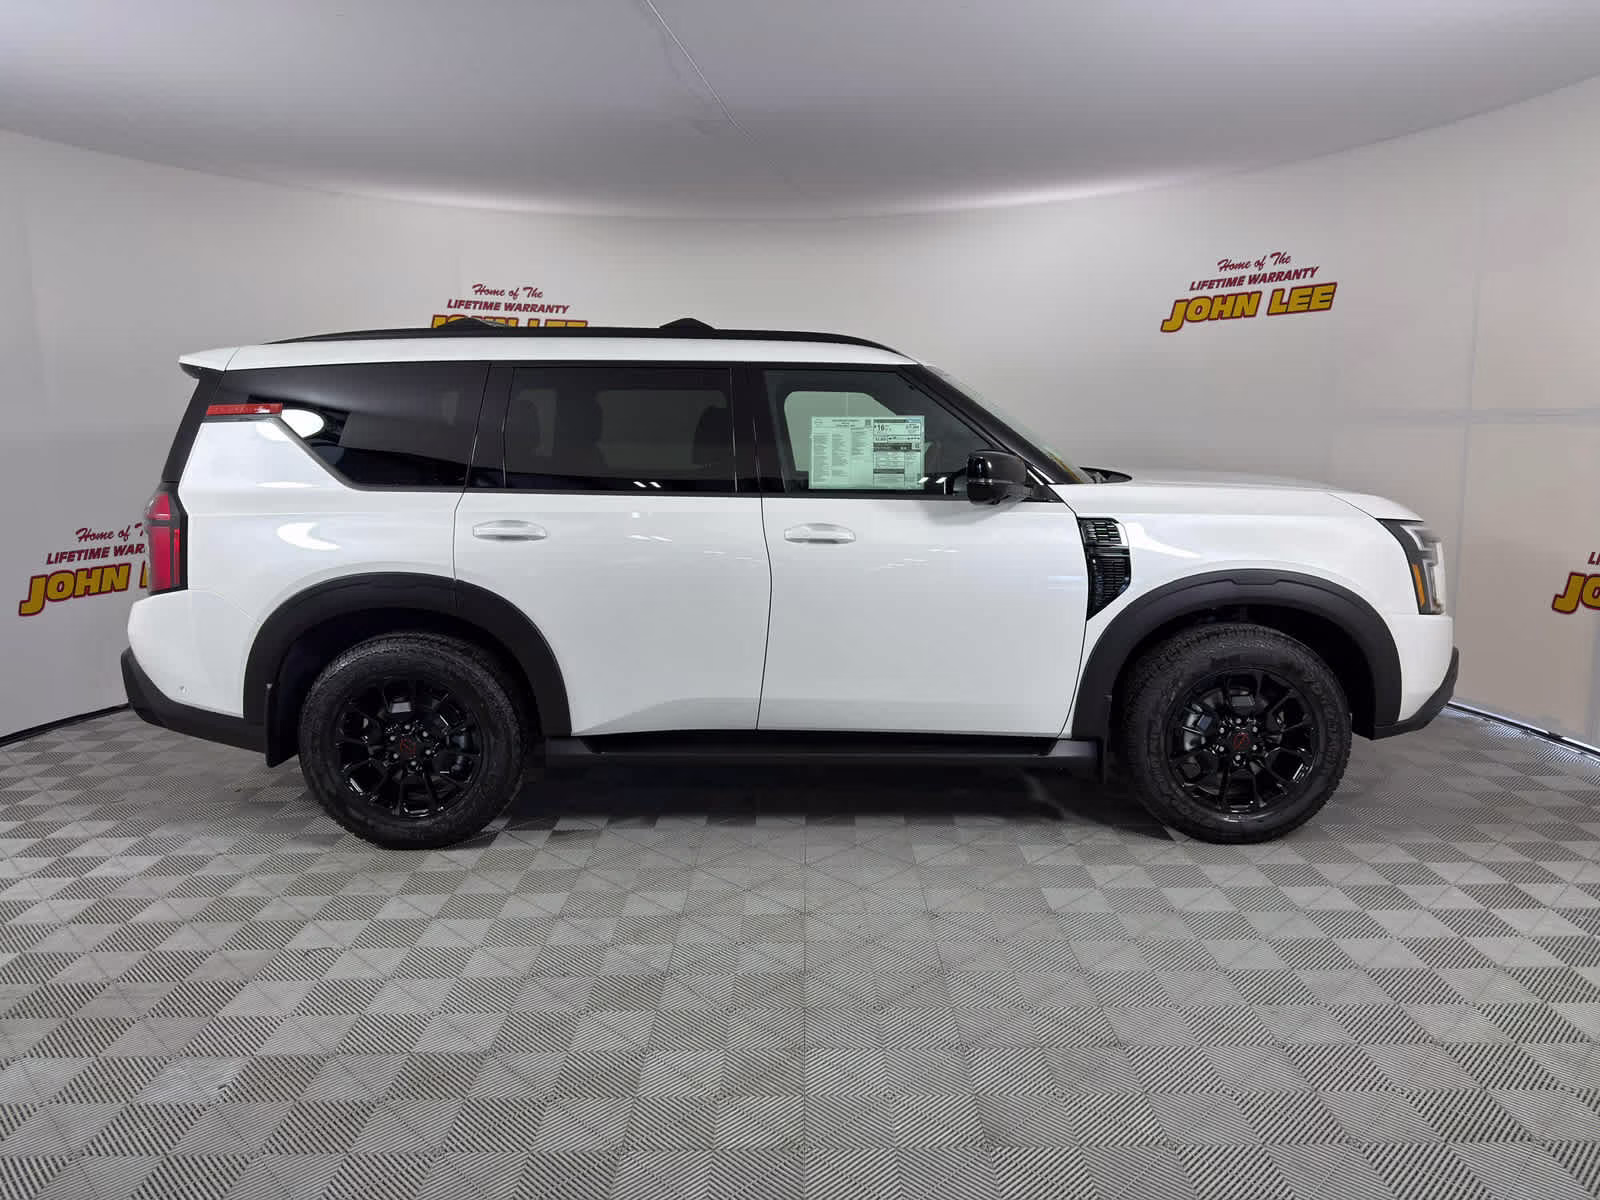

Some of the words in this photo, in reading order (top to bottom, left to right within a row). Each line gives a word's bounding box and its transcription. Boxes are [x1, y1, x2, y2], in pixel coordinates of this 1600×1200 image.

[1217, 259, 1251, 272] Home
[1254, 256, 1266, 270] of
[1270, 251, 1291, 265] The
[1189, 275, 1246, 291] LIFETIME
[1248, 266, 1319, 285] WARRANTY
[472, 283, 505, 297] Home
[508, 287, 520, 300] of
[522, 286, 543, 298] The
[447, 299, 502, 311] LIFETIME
[504, 302, 569, 314] WARRANTY
[1160, 291, 1262, 333] JOHN
[1267, 282, 1338, 316] LEE
[75, 528, 114, 542] Home
[118, 525, 131, 541] of
[46, 546, 110, 565] LIFETIME
[18, 562, 132, 617] JOHN
[1551, 571, 1600, 615] JO
